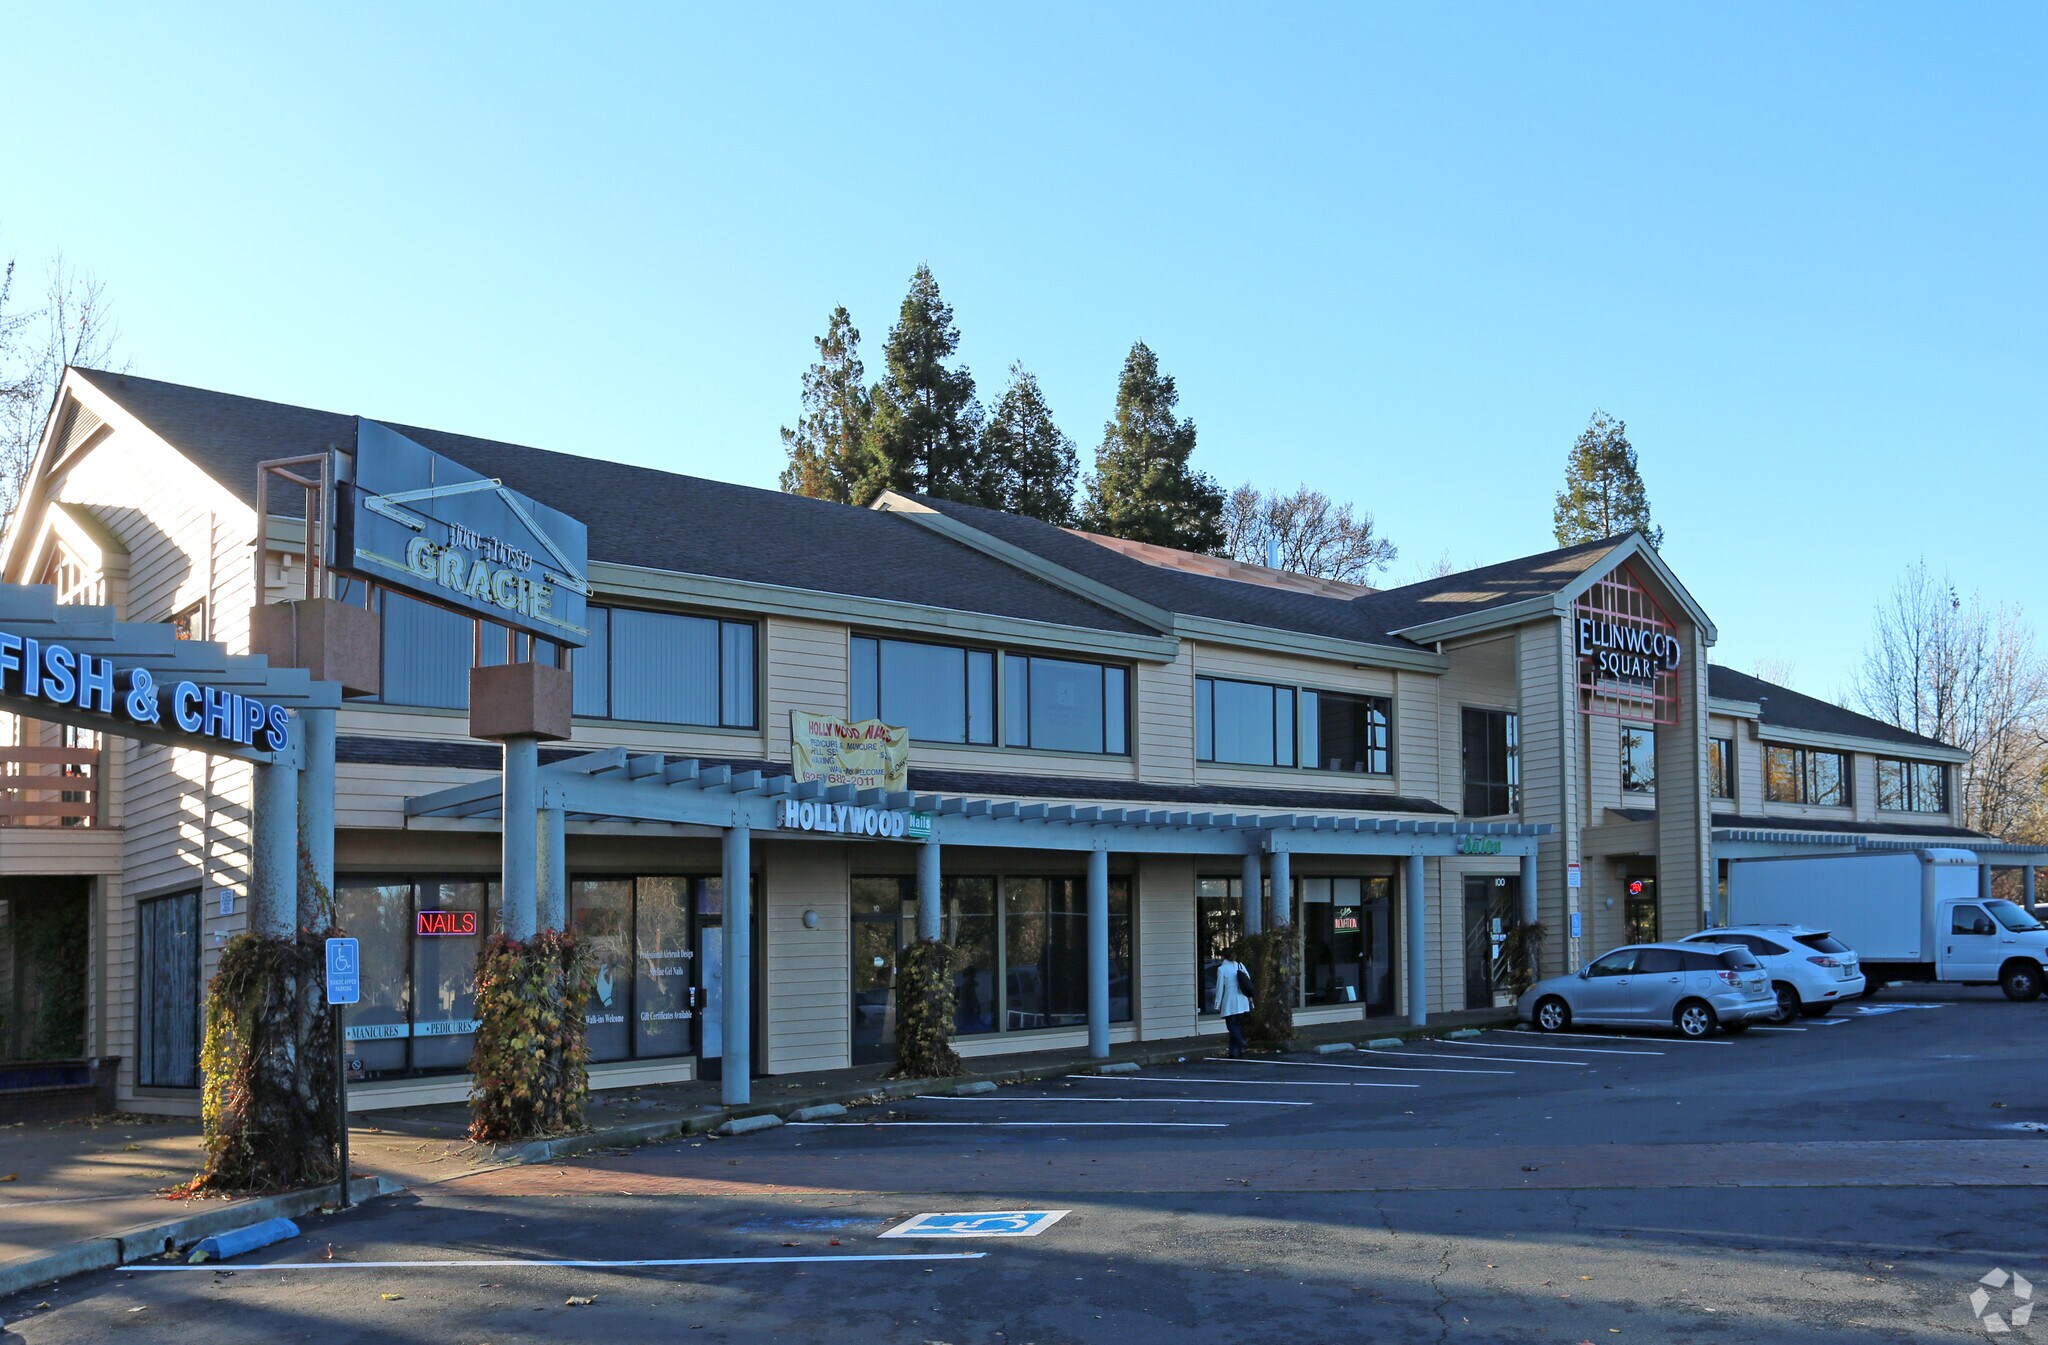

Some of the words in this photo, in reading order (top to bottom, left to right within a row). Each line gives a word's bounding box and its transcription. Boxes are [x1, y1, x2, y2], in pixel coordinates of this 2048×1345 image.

[405, 536, 554, 620] GRACIE
[1580, 618, 1680, 670] ELLINWOOD
[1599, 650, 1661, 680] SQUARE
[0, 632, 113, 713] FISH
[126, 667, 161, 725] &
[174, 681, 289, 751] CHIPS
[828, 772, 876, 787] 682-2011
[785, 799, 904, 838] HOLLYWOOD
[909, 814, 931, 829] Nails
[1495, 877, 1506, 887] 100
[419, 913, 474, 933] NAILS
[431, 1020, 473, 1035] PEDICURES
[585, 1014, 605, 1024] Walk-ins
[605, 1013, 624, 1023] Welcome
[351, 1025, 399, 1039] MANICURES
